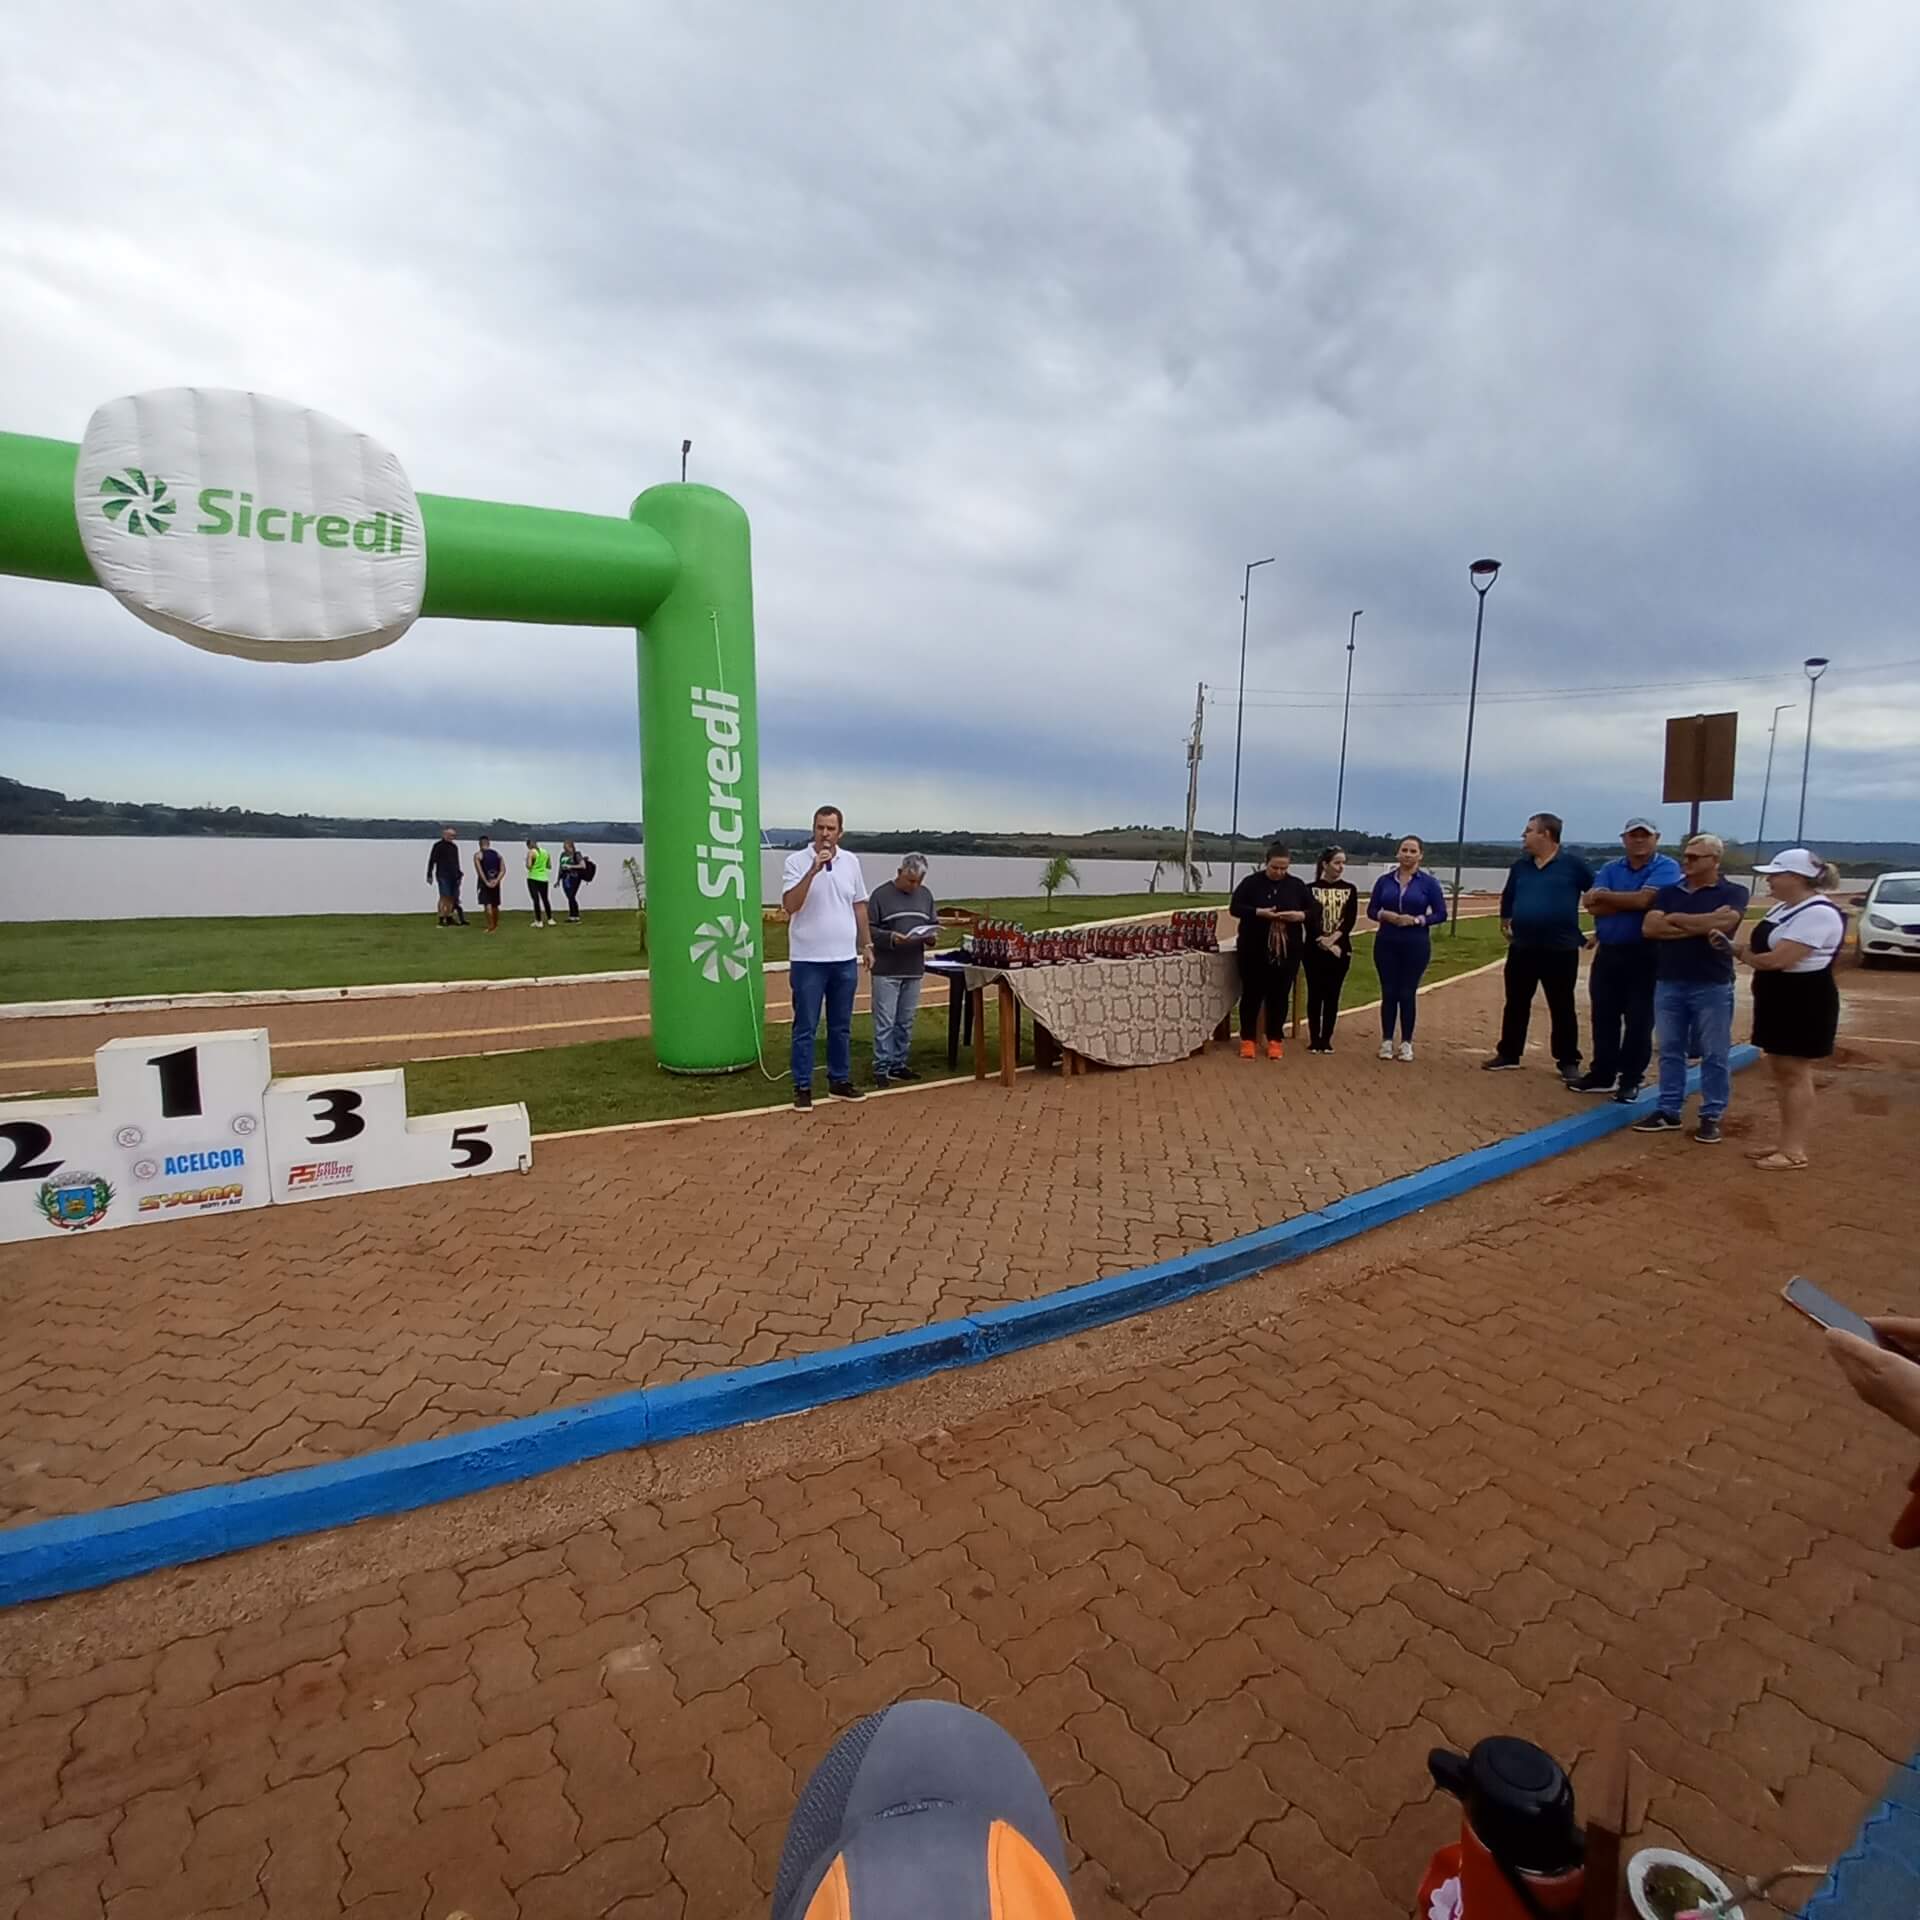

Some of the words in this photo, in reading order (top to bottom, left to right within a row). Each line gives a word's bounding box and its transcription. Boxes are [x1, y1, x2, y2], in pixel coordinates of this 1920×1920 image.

[197, 488, 403, 555] Sicredi
[690, 685, 745, 901] Sicredi
[147, 1046, 203, 1118] 1
[306, 1089, 366, 1145] 3
[450, 1124, 494, 1169] 5
[0, 1122, 64, 1181] 2
[165, 1148, 245, 1175] ACELCOR
